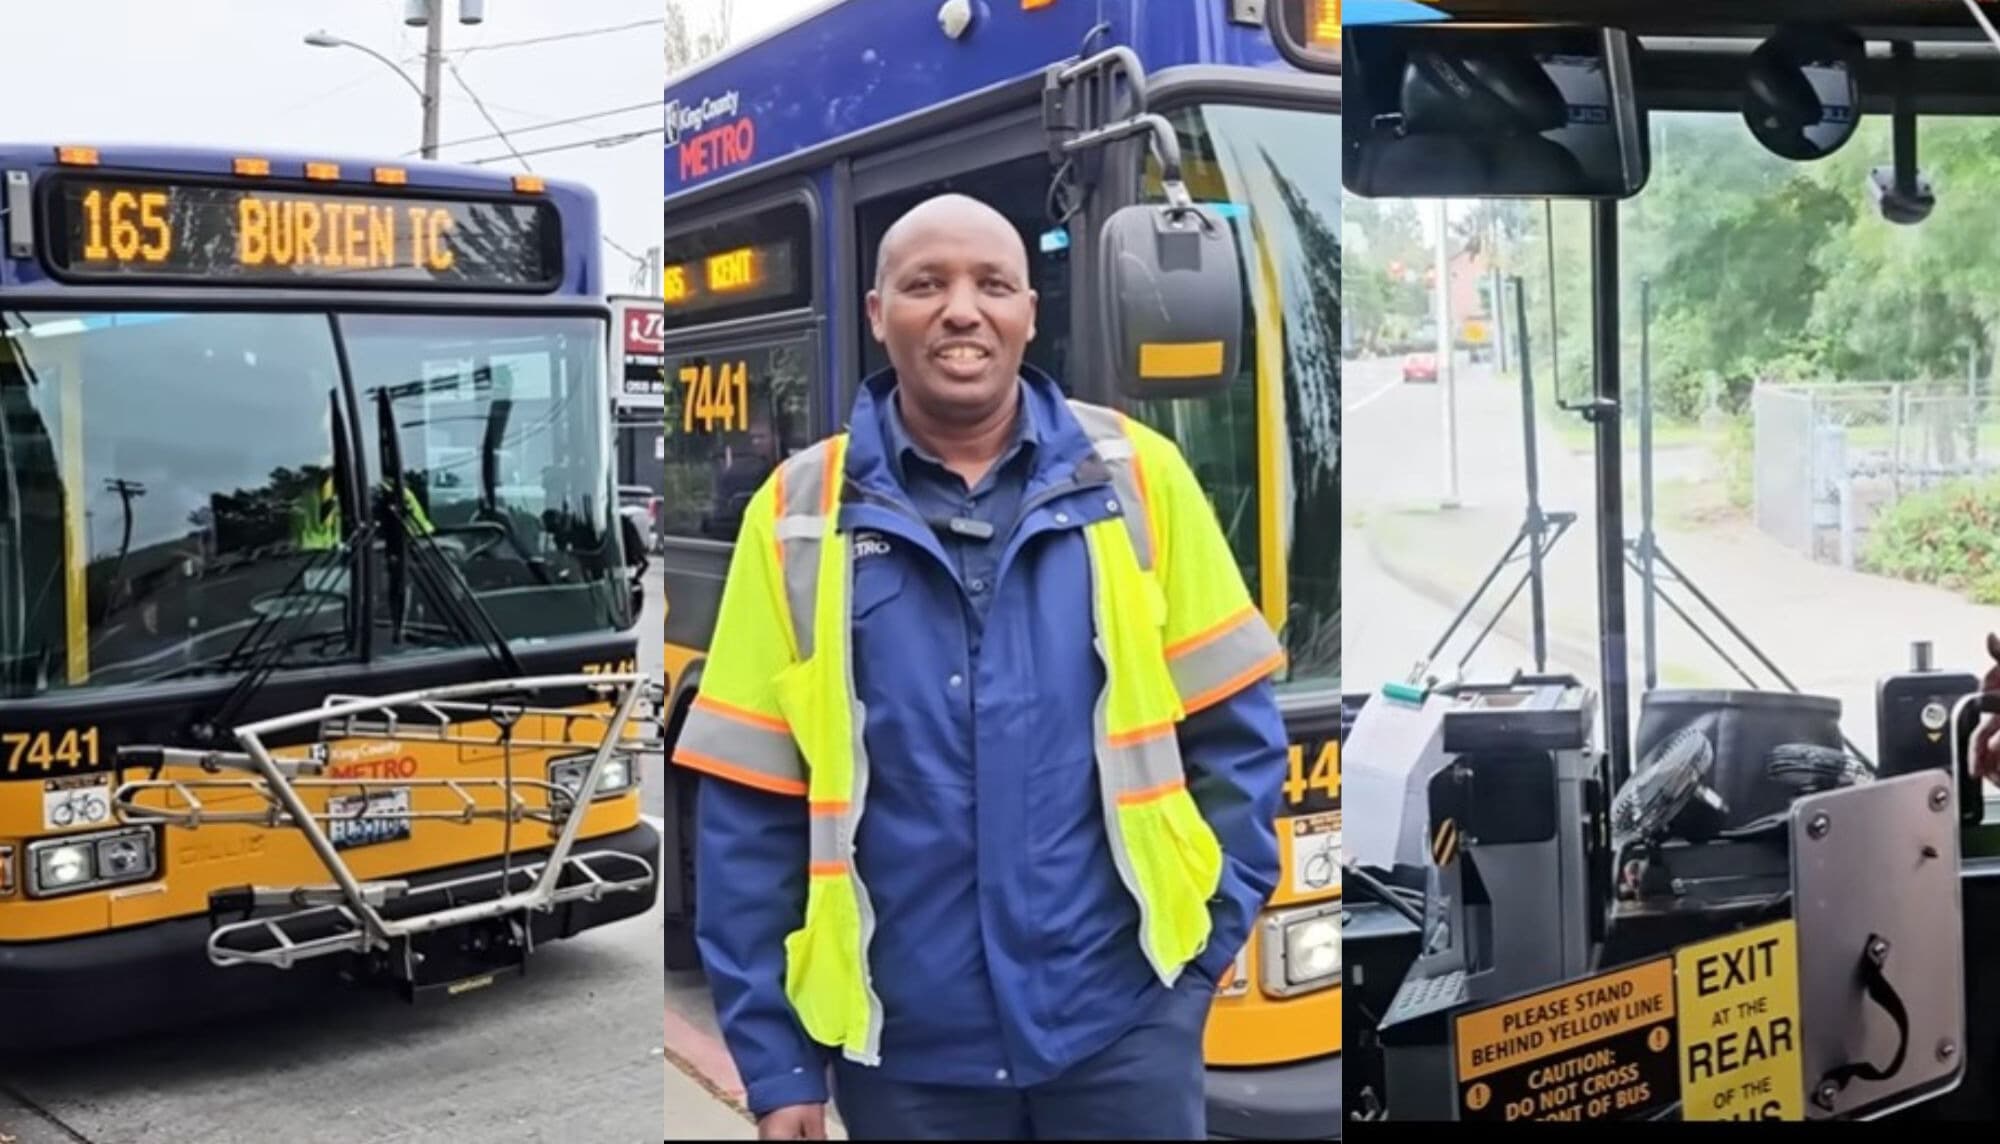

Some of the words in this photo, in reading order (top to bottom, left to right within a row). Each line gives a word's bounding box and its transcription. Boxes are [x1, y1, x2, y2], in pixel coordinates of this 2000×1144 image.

[680, 106, 701, 131] King
[702, 90, 739, 120] County
[680, 117, 755, 181] METRO
[83, 189, 171, 261] 165
[238, 196, 396, 268] BURIEN
[407, 207, 455, 271] TC
[679, 360, 748, 433] 7441
[2, 726, 99, 772] 7441
[330, 756, 417, 779] METRO
[1697, 938, 1779, 997] EXIT
[1471, 1032, 1543, 1067] BEHIND
[1548, 1009, 1621, 1043] YELLOW
[1625, 994, 1664, 1020] LINE
[1503, 999, 1569, 1033] PLEASE
[1575, 980, 1634, 1011] STAND
[1712, 1008, 1731, 1027] AT
[1737, 997, 1768, 1018] THE
[1527, 1050, 1617, 1089] CAUTION:
[1687, 1016, 1793, 1083] REAR
[1505, 1097, 1534, 1121] DO
[1540, 1081, 1581, 1110] NOT
[1582, 1062, 1639, 1096] CROSS
[1587, 1094, 1613, 1117] OF
[1616, 1083, 1651, 1109] BUS
[1713, 1088, 1735, 1109] OF
[1741, 1076, 1772, 1099] THE
